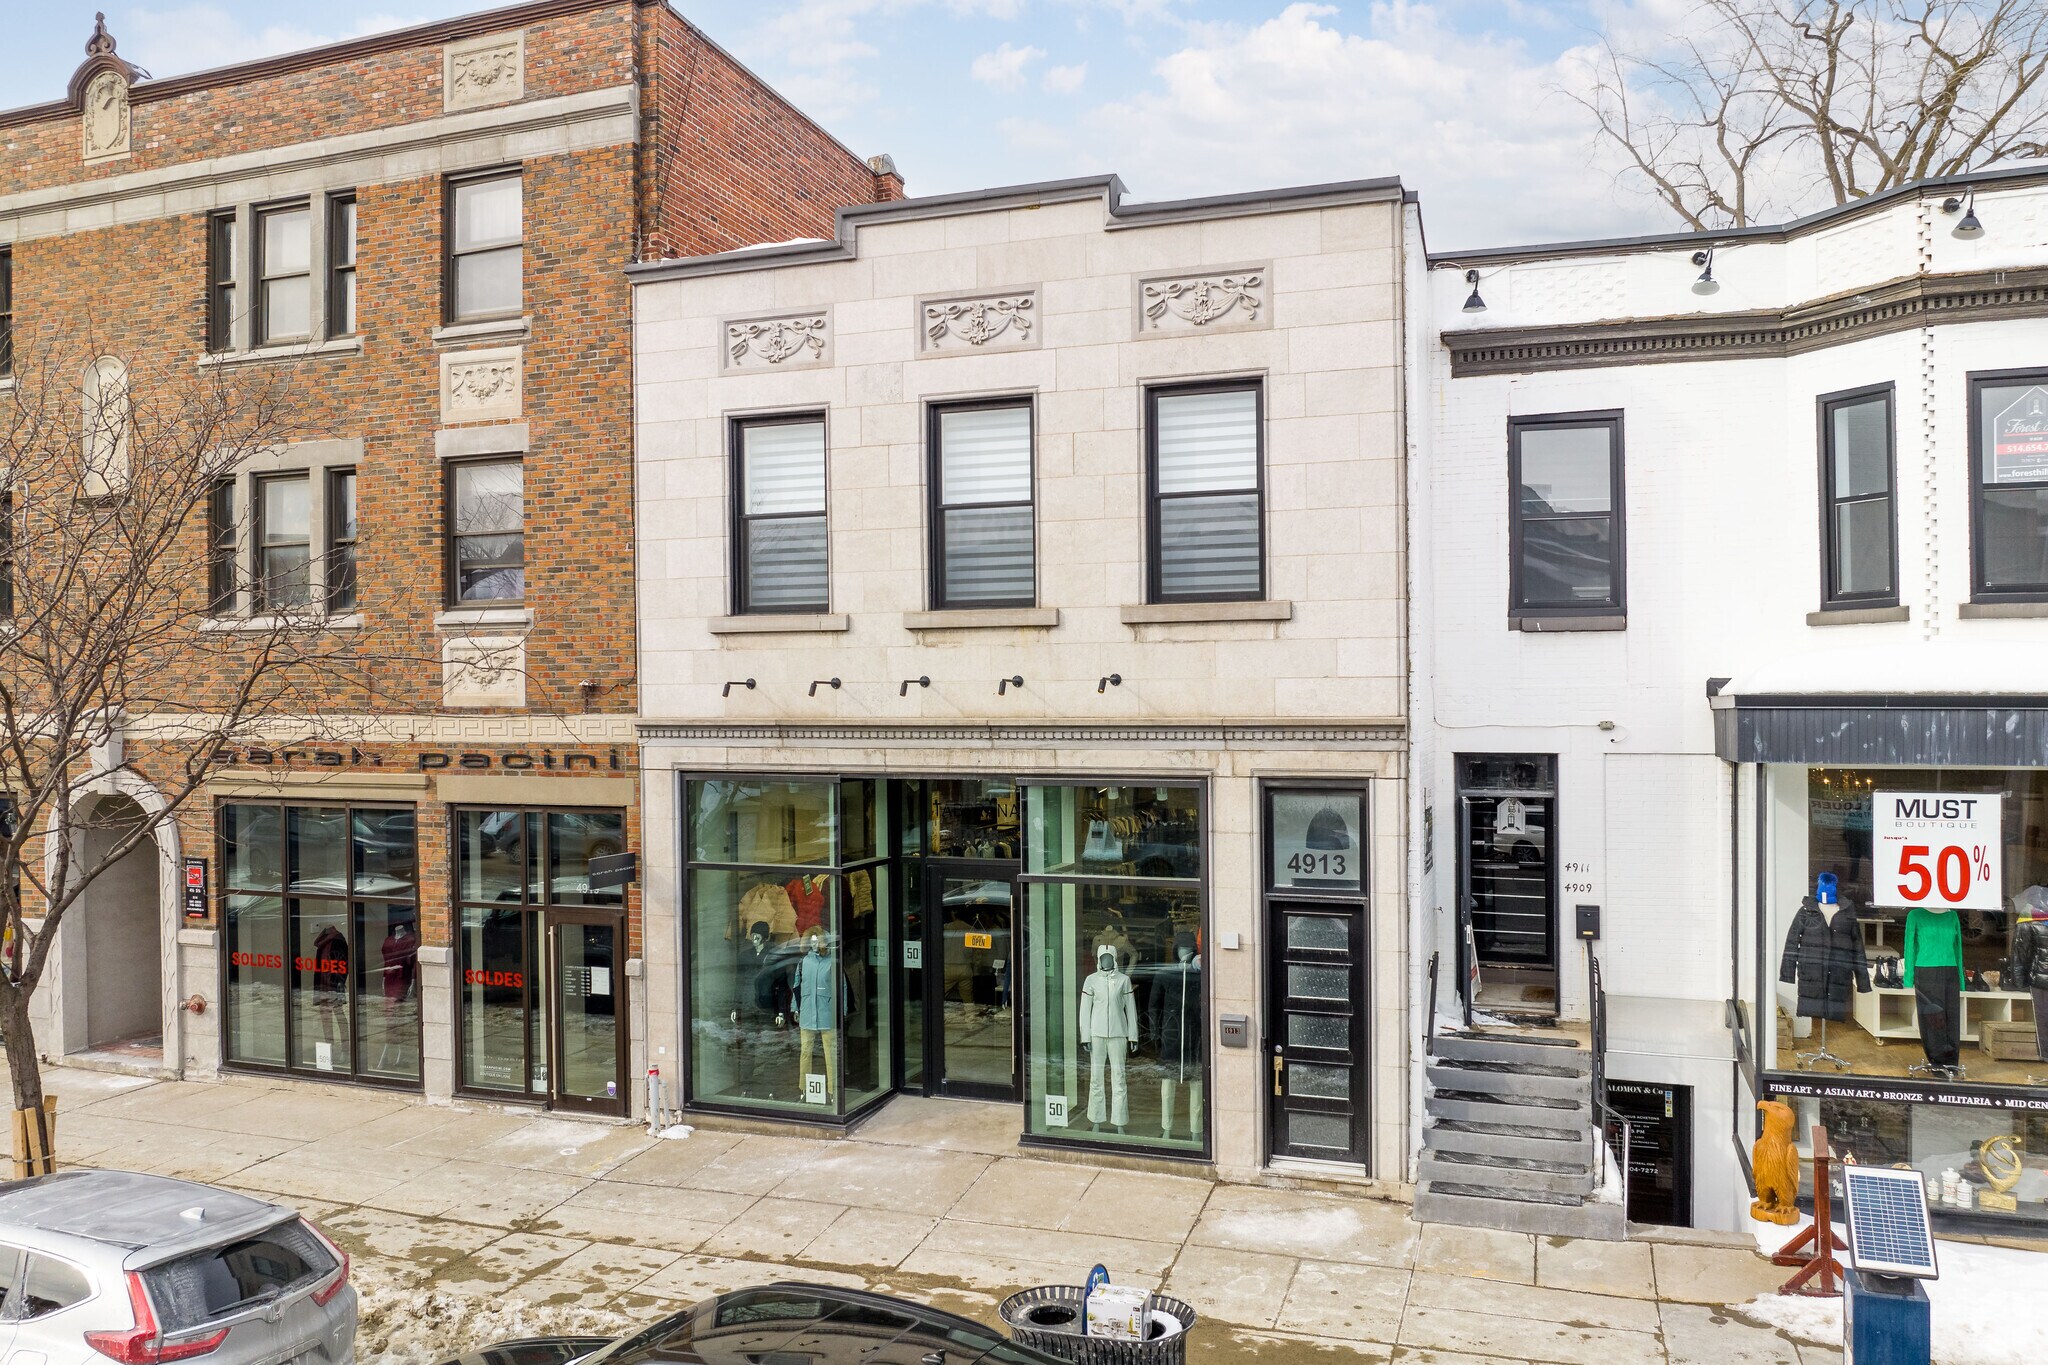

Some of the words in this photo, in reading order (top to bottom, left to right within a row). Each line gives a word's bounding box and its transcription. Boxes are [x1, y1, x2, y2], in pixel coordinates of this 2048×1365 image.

[2004, 418, 2041, 433] Forest
[209, 747, 382, 766] sarah
[418, 748, 617, 770] pacini
[1895, 798, 1978, 819] MUST
[1895, 821, 1977, 829] BOUTIQUE
[1287, 853, 1346, 875] 4913
[1564, 862, 1590, 873] 4911
[1564, 883, 1593, 893] 4909
[231, 951, 282, 969] SOLDES
[295, 957, 347, 974] SOLDES
[465, 969, 524, 988] SOLDES
[1605, 1084, 1642, 1094] ALOMON
[1652, 1087, 1663, 1095] Co
[1769, 1083, 1792, 1092] FINE
[1792, 1085, 1812, 1094] ART
[1824, 1087, 1854, 1097] ASIAN
[1856, 1089, 1875, 1099] ART
[1882, 1091, 1923, 1101] BRONZE
[1938, 1094, 1992, 1106] MILITARIA
[2005, 1098, 2027, 1108] MID
[1628, 1166, 1659, 1174] 04-7272
